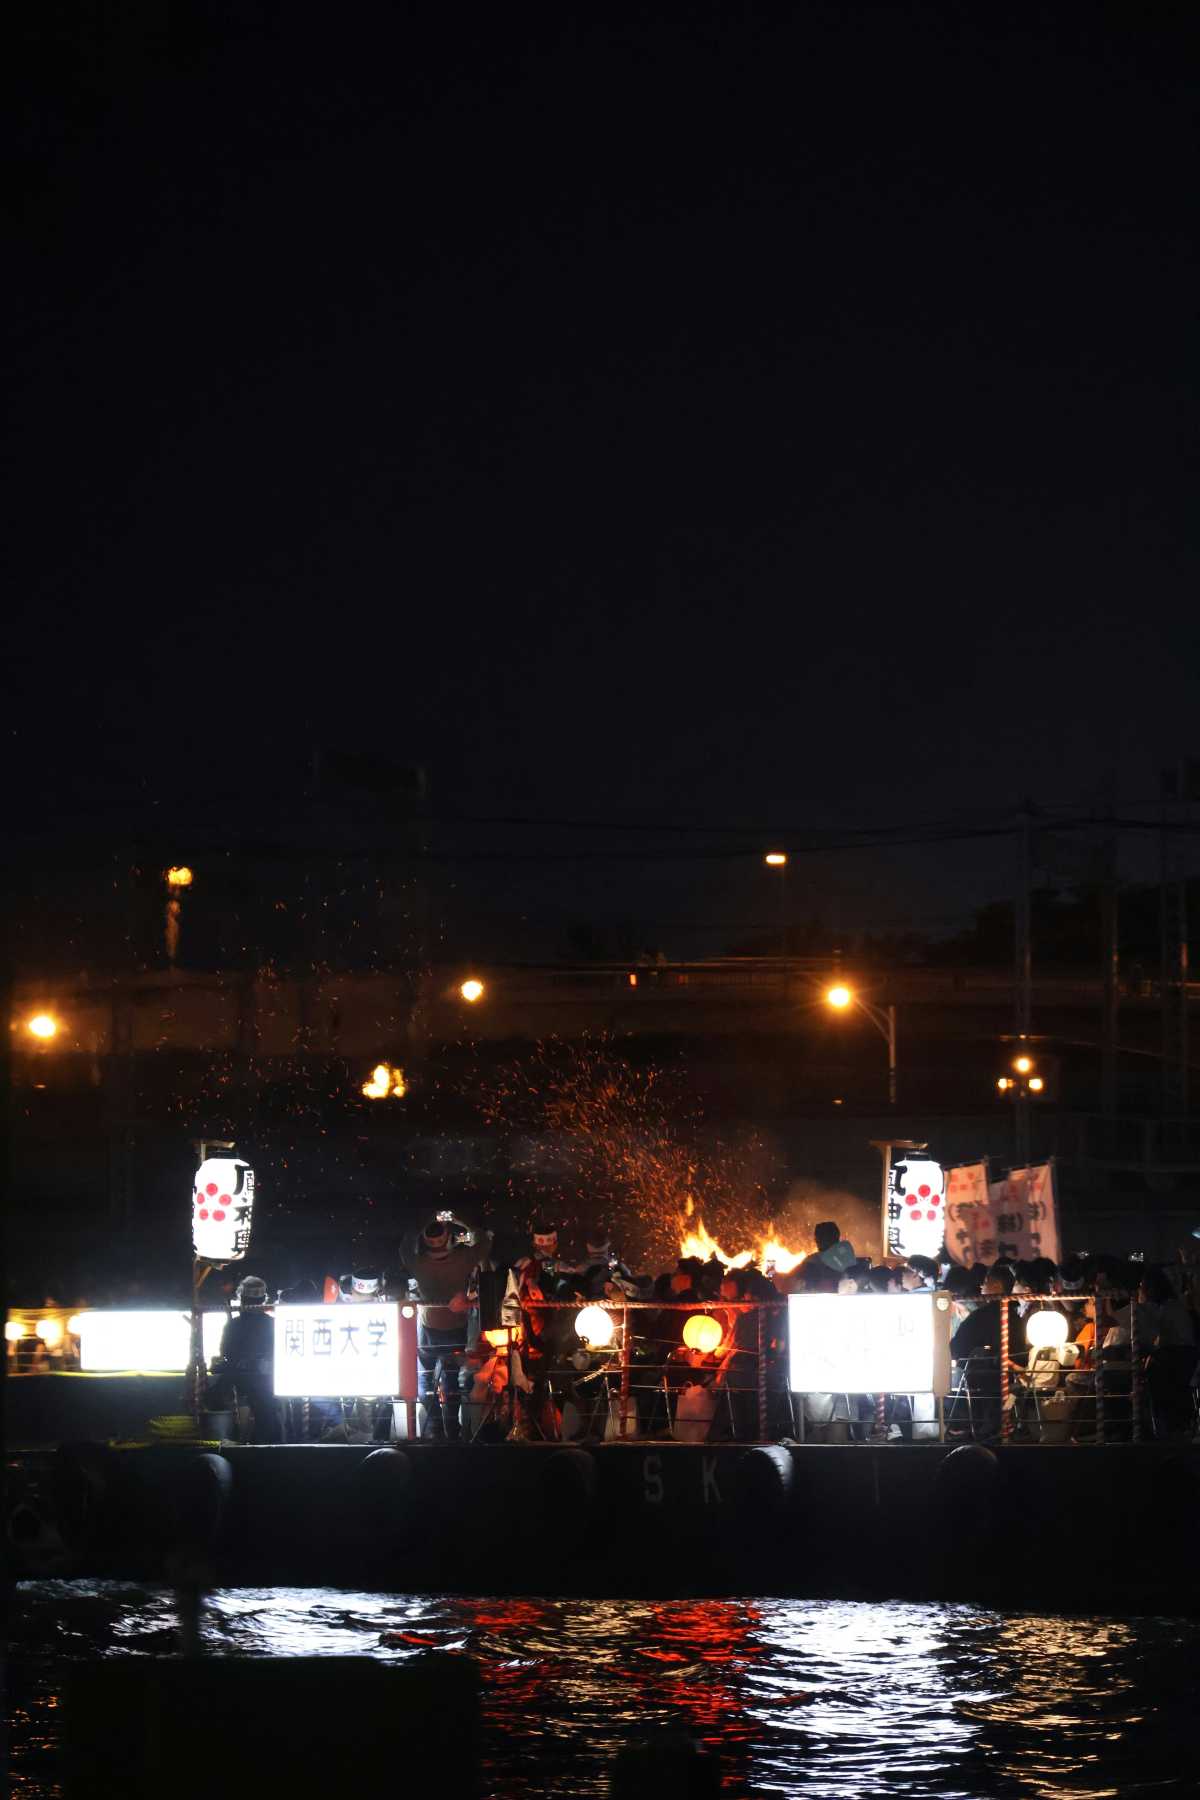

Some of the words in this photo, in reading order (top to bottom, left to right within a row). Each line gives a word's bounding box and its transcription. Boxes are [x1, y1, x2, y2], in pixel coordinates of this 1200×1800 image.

[285, 1319, 388, 1357] 関西大学
[643, 1455, 664, 1503] S
[702, 1455, 724, 1504] K
